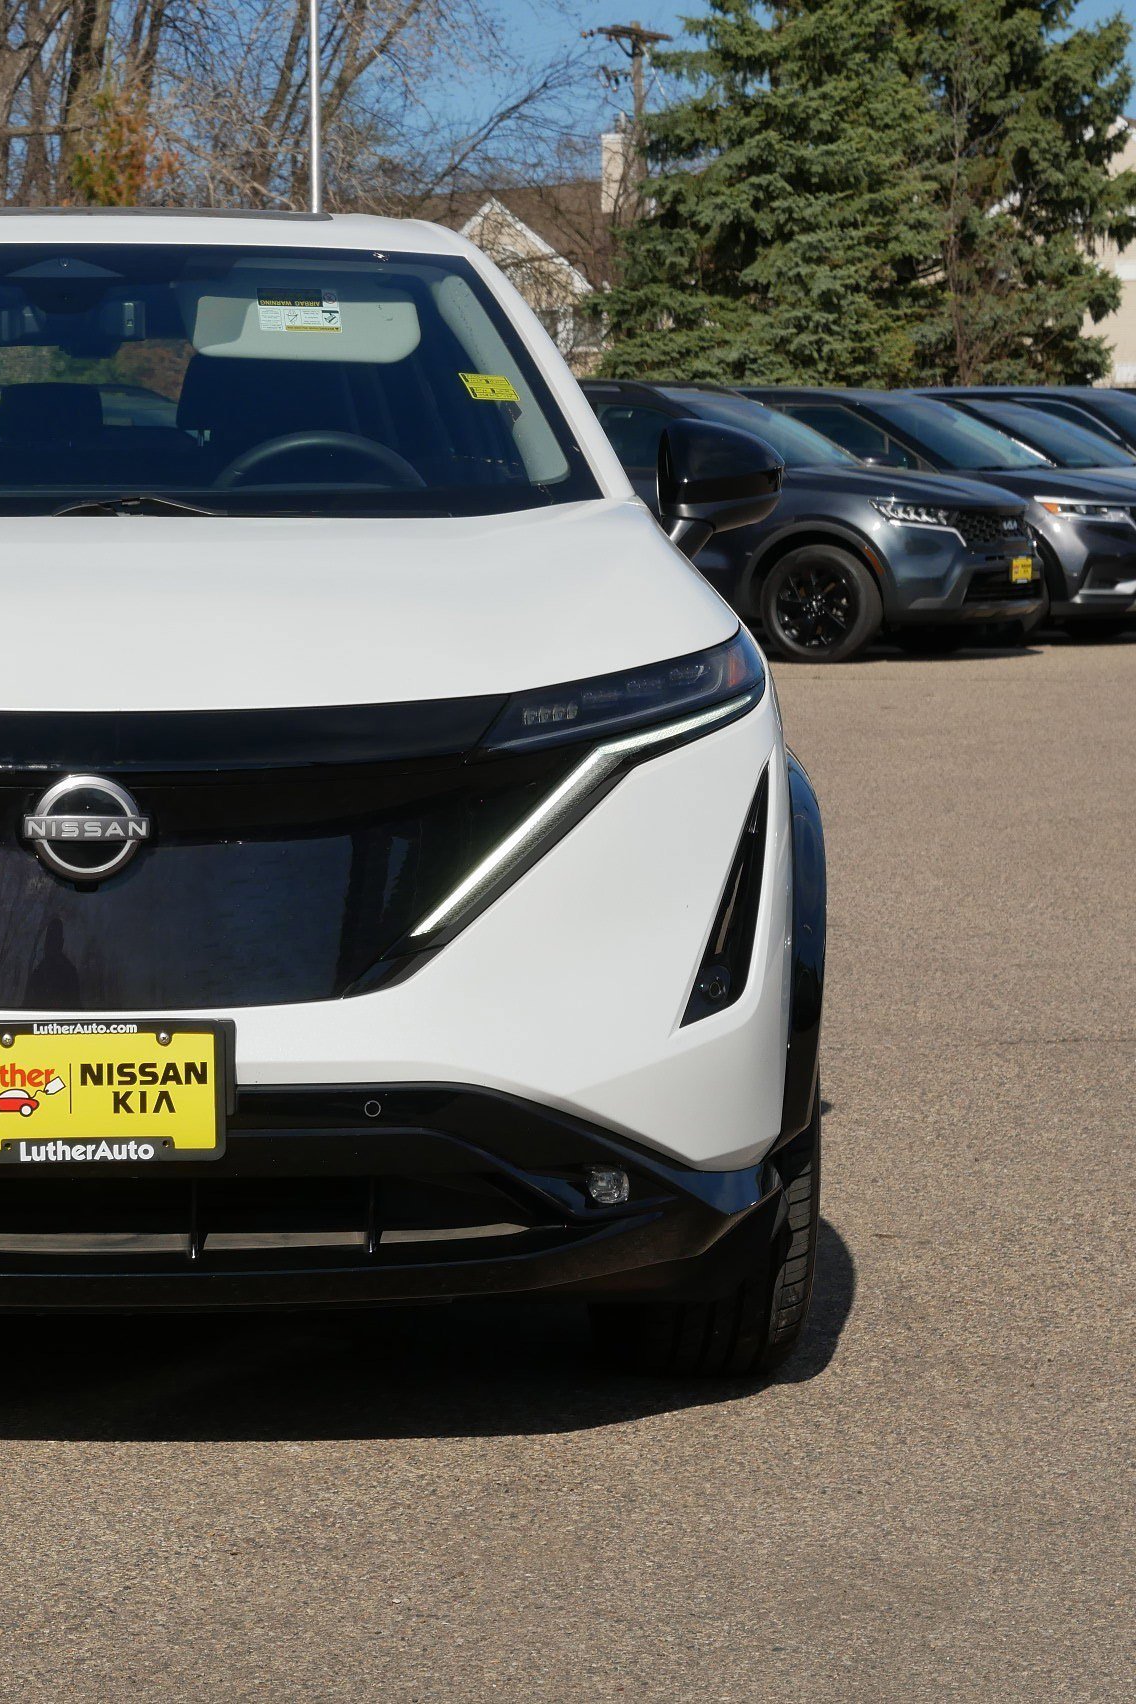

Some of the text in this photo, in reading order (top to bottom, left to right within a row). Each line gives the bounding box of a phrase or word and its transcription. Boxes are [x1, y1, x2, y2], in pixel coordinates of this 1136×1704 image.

[27, 821, 147, 837] NISSAN
[33, 1023, 138, 1035] LutherAuto.com
[80, 1062, 208, 1086] NISSAN
[113, 1091, 177, 1114] KIA
[19, 1140, 155, 1162] LutherAuto
